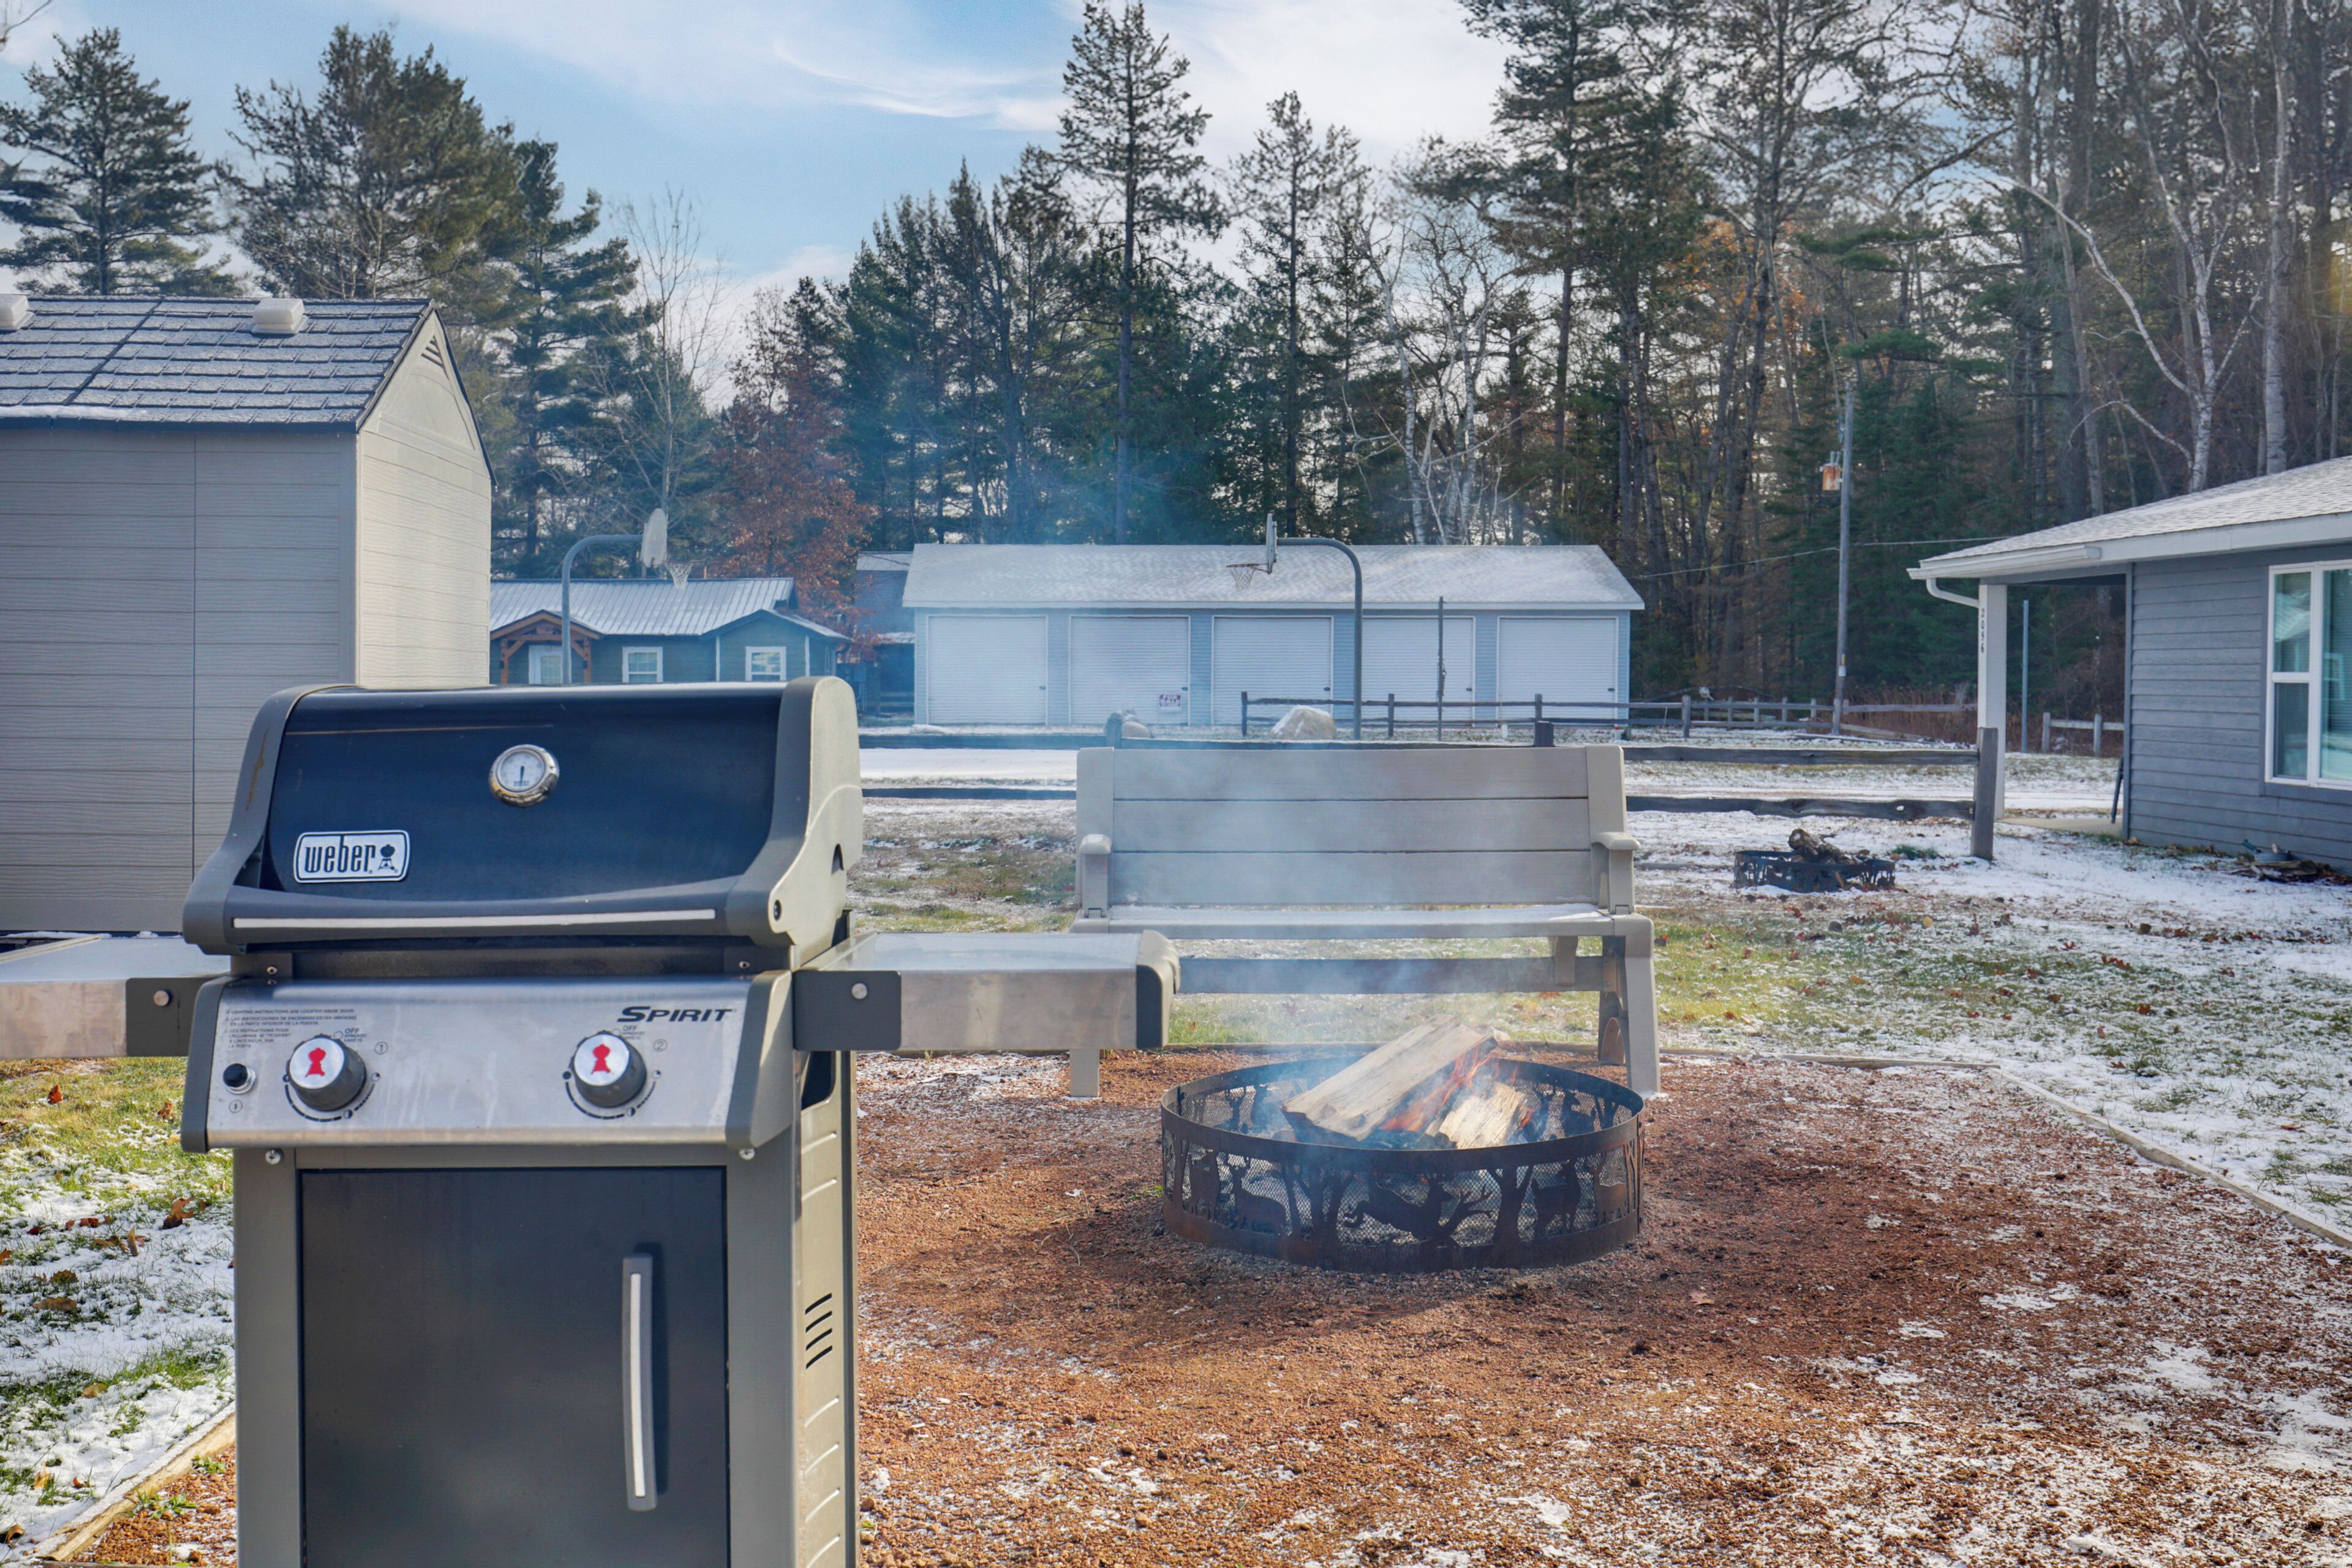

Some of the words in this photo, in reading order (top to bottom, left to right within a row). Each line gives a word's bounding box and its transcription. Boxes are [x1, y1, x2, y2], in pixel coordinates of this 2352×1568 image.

[304, 835, 376, 873] weber
[617, 1006, 733, 1022] SPIRIT
[657, 1041, 664, 1050] 2
